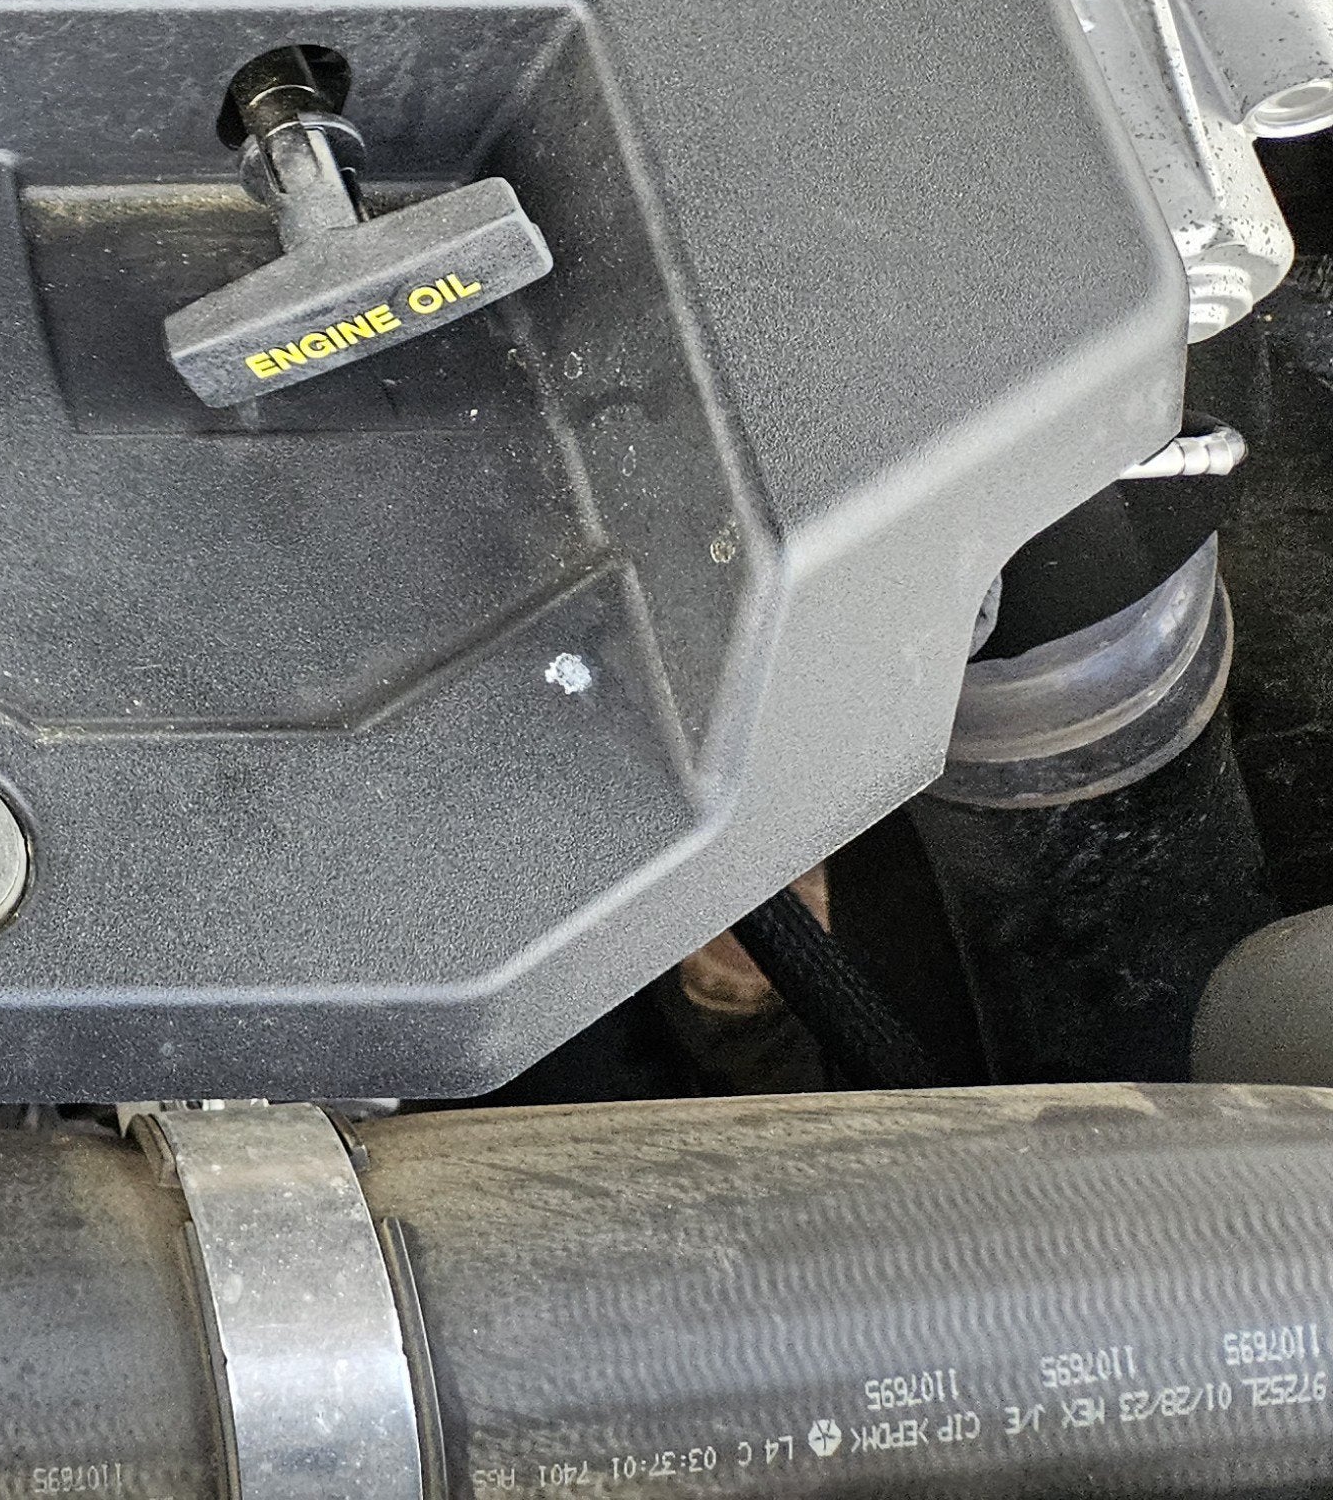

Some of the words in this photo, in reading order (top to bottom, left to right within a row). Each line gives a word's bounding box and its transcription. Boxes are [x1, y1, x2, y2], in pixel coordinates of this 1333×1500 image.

[244, 303, 403, 380] ENGINE
[407, 272, 482, 316] OIL
[1223, 1323, 1320, 1366] 1107695
[1040, 1345, 1137, 1388] 1107695
[865, 1367, 960, 1411] 1107695
[1118, 1381, 1233, 1422] 01/28/23
[1061, 1396, 1106, 1429] MEX
[33, 1461, 122, 1494] 1107695
[539, 1460, 591, 1488] 7401
[612, 1445, 717, 1478] 03:37:01
